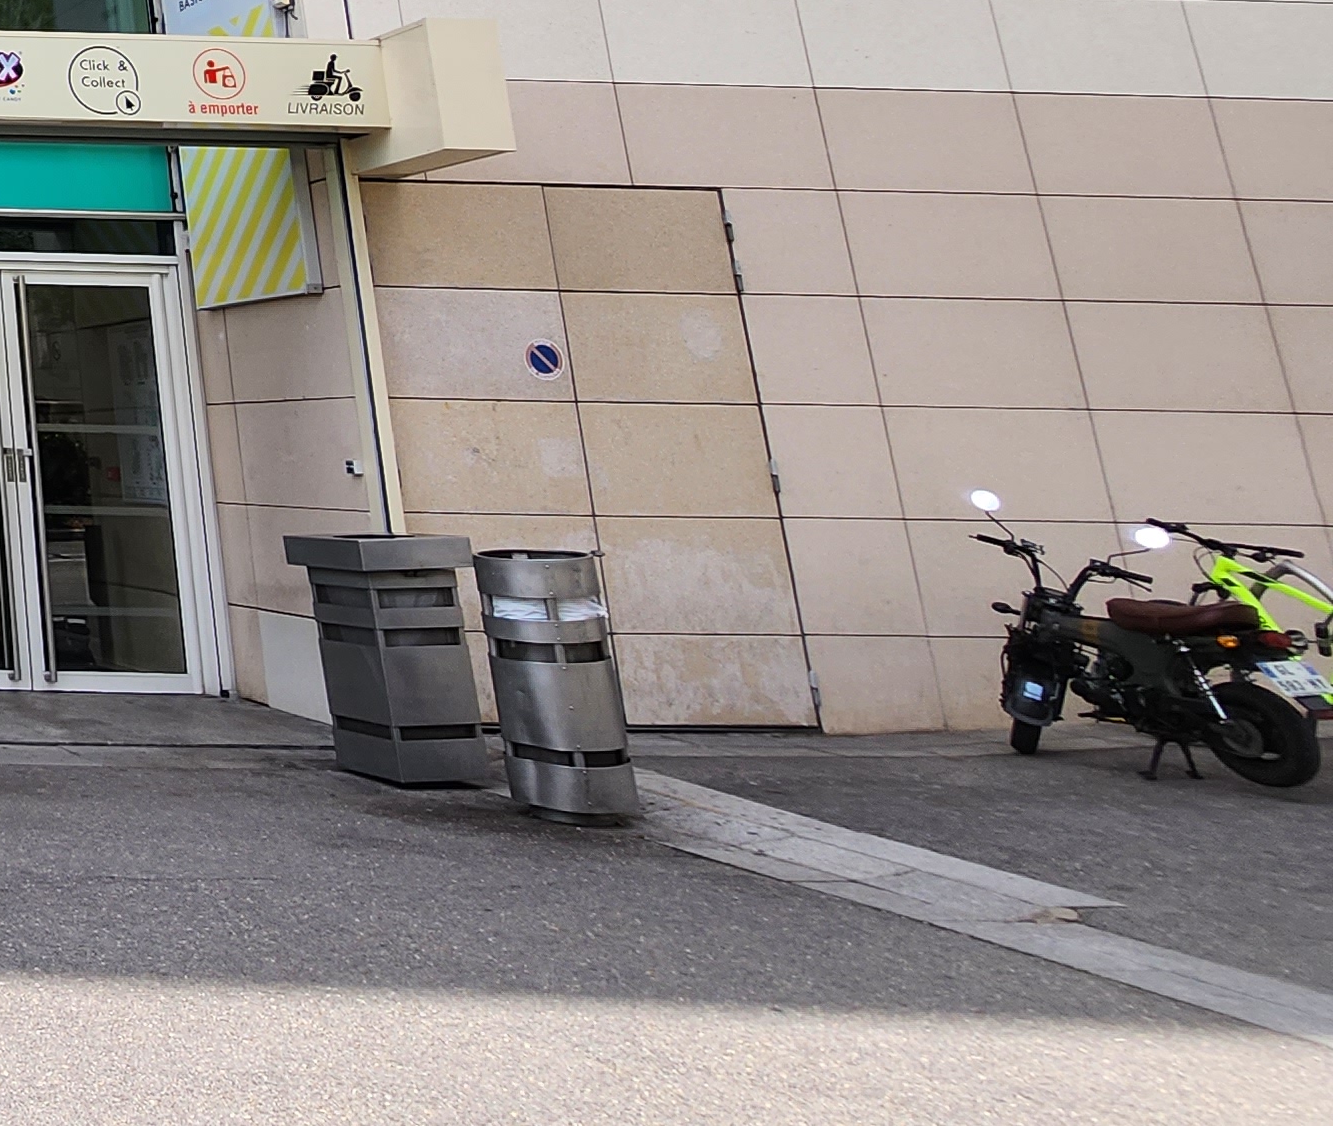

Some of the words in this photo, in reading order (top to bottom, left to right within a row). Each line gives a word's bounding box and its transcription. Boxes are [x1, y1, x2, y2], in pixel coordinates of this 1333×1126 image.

[80, 59, 110, 72] Click
[118, 60, 129, 72] &
[81, 75, 126, 89] Collect
[188, 101, 197, 114] à
[200, 102, 259, 117] emporter
[287, 102, 364, 115] LIVRAISON
